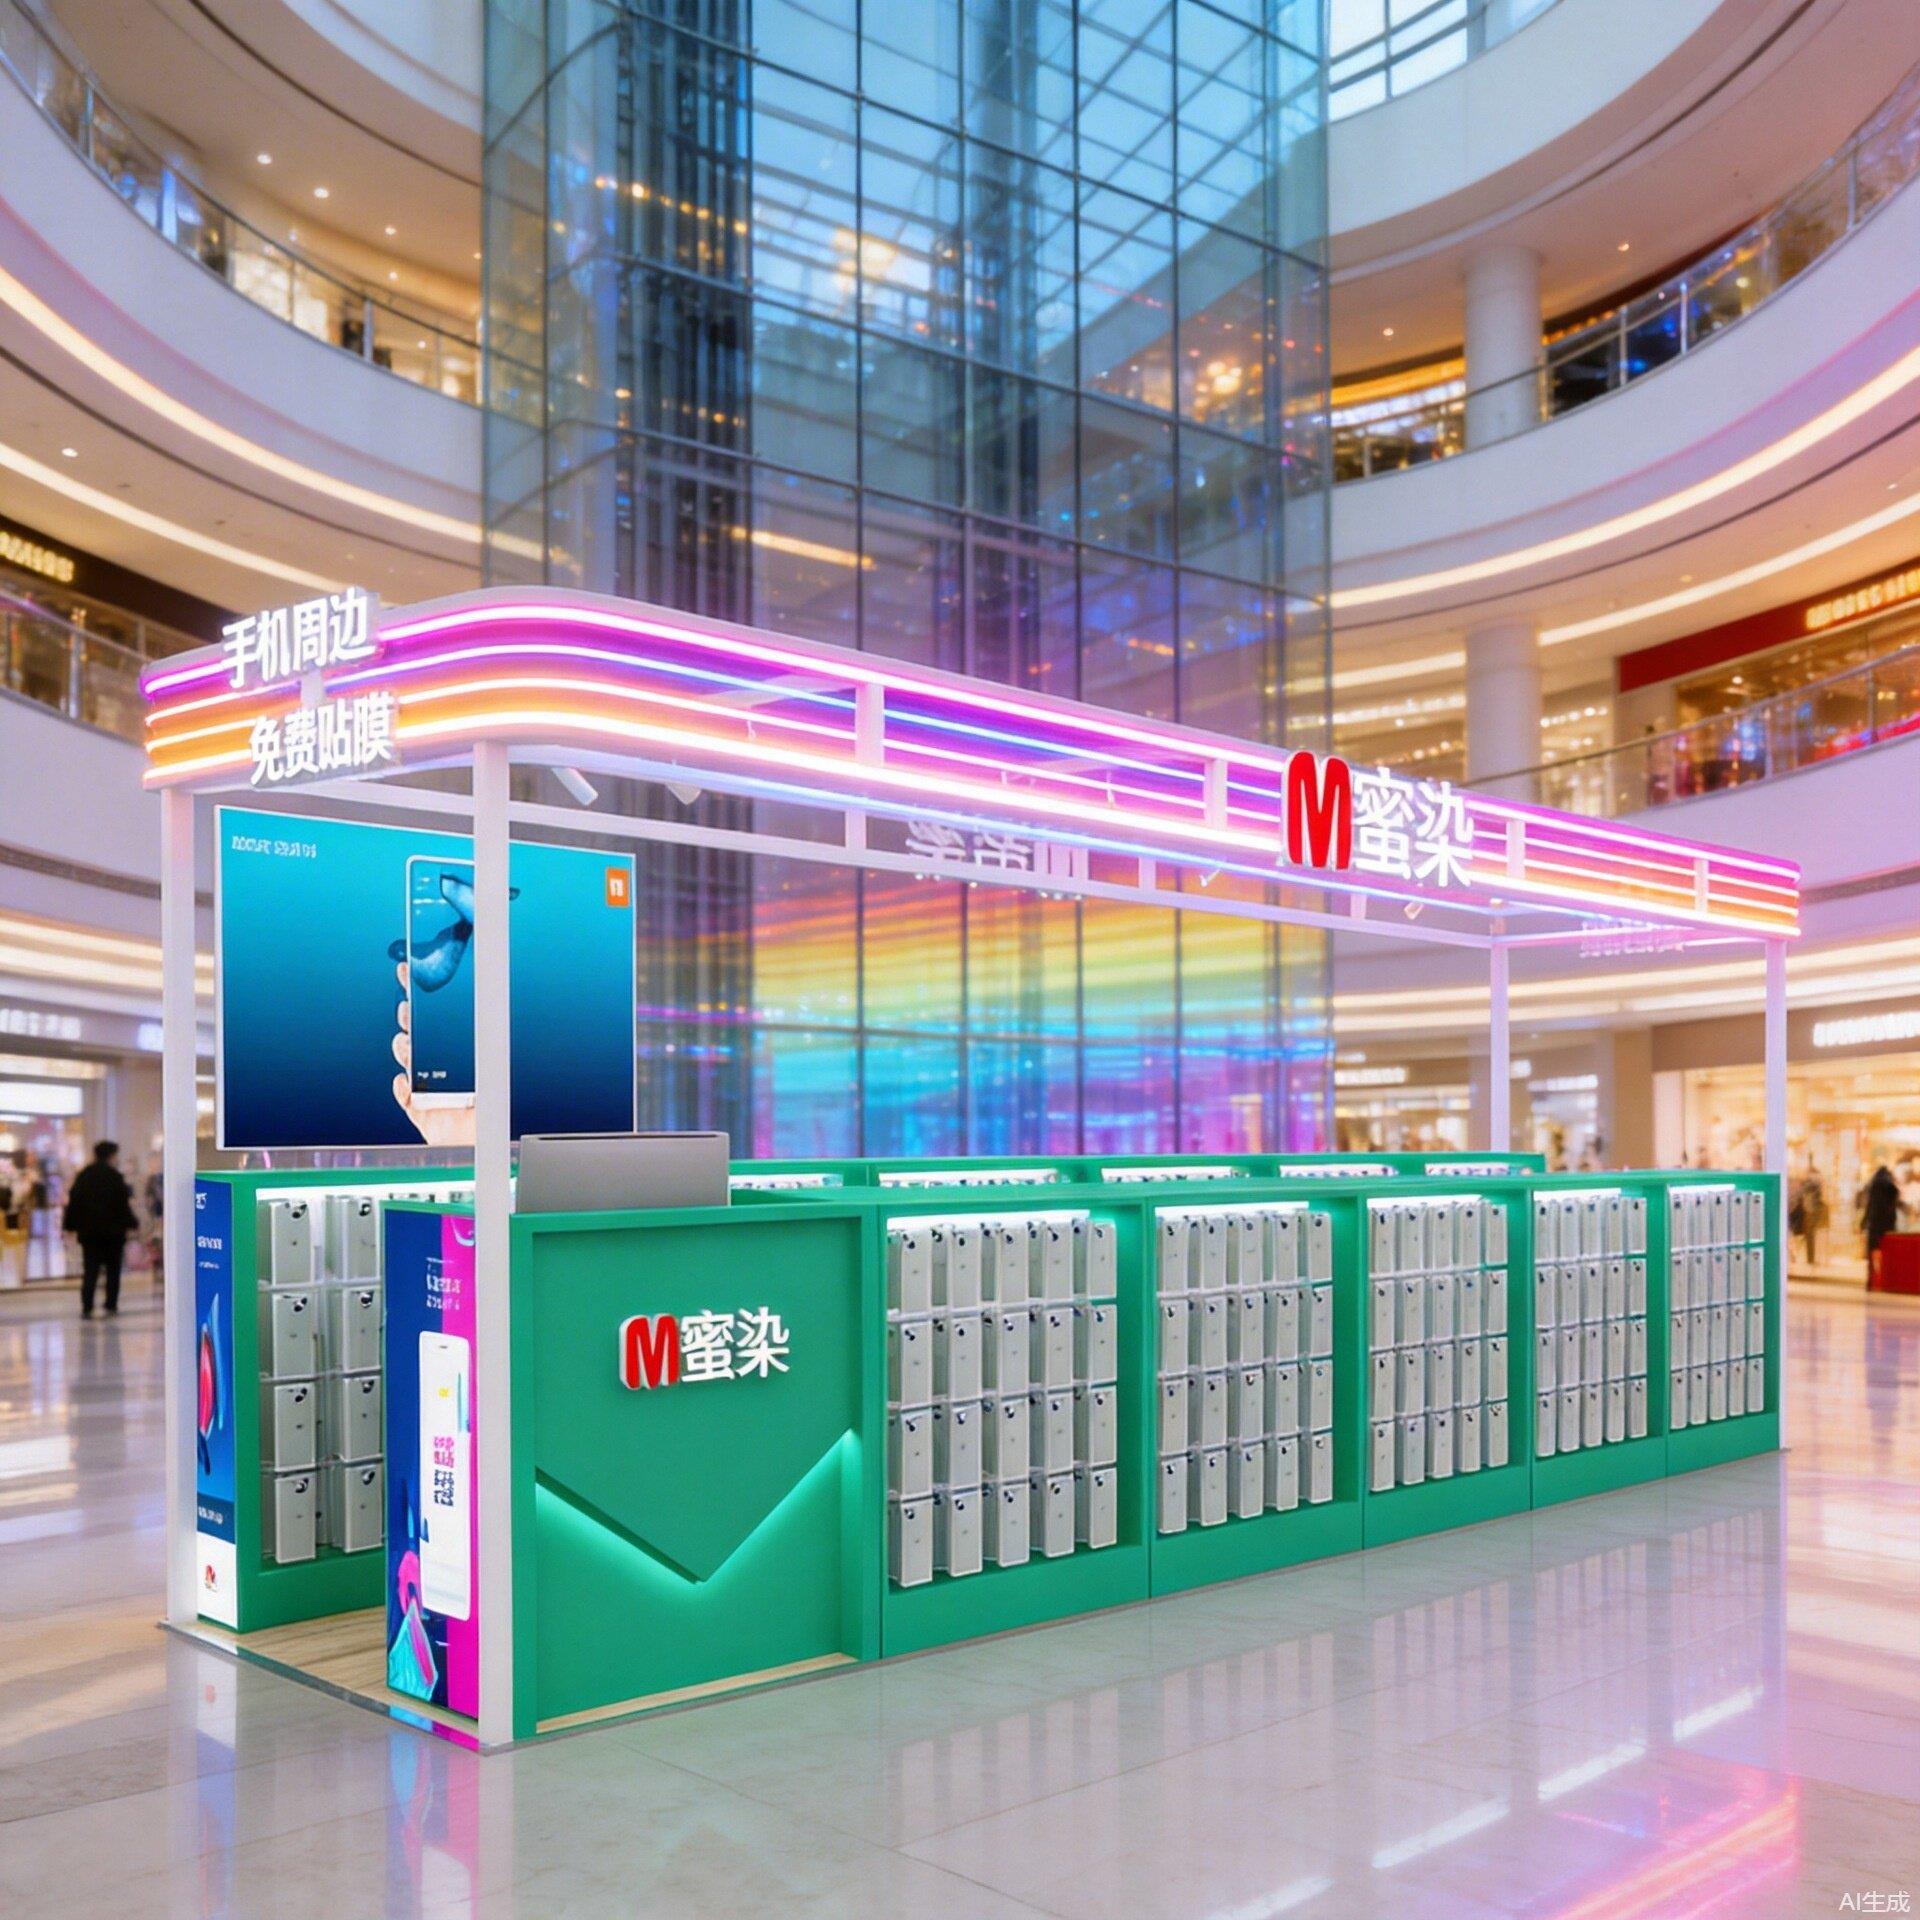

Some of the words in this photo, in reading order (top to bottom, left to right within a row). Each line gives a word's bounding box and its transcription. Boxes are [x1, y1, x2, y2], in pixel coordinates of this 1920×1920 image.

[222, 586, 376, 688] 手机周边
[250, 691, 395, 785] 免费贴膜
